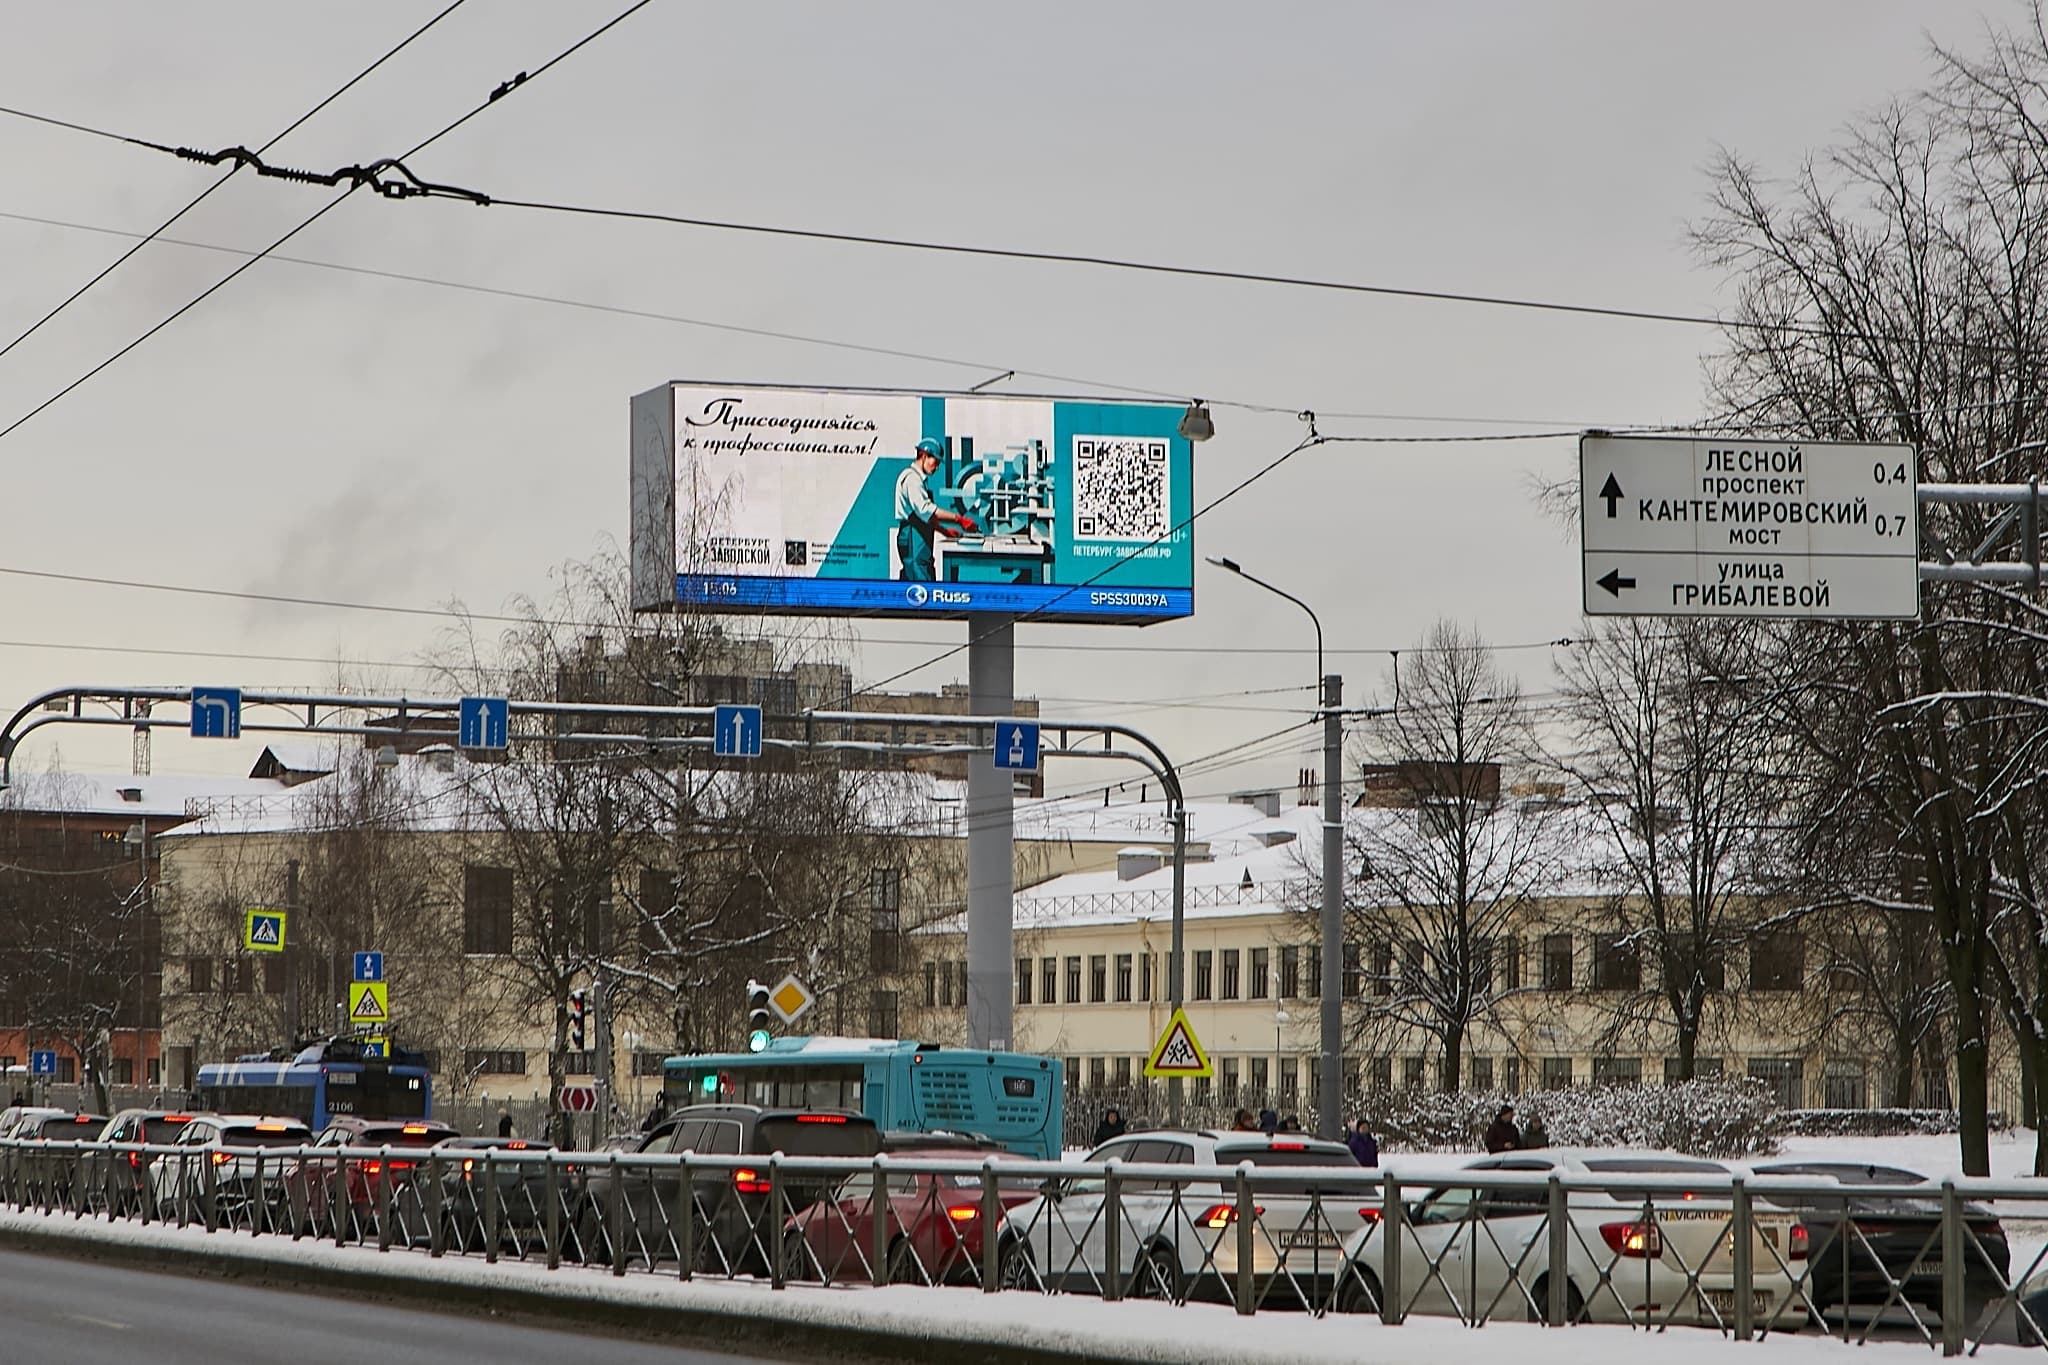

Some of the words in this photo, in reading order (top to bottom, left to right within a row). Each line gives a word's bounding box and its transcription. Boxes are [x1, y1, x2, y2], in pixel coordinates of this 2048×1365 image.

[685, 398, 878, 434] Присоединяйся
[684, 437, 697, 449] к
[703, 433, 878, 456] профессионалам!
[1705, 446, 1802, 473] ЛЕСНОЙ
[1873, 463, 1907, 485] 0,4
[1702, 477, 1805, 498] проспект
[1639, 497, 1867, 524] КАНТЕМИРОВСКИЙ
[1729, 529, 1781, 545] мост
[1875, 515, 1907, 538] 0,7
[710, 537, 770, 548] ПЕТЕРБУРГ
[710, 548, 770, 565] ЗАВОДСКОЙ
[1718, 562, 1784, 583] улица
[932, 589, 971, 603] Russ
[1090, 592, 1169, 608] SPSS30039A
[1672, 580, 1830, 608] ГРИБАЛЕВОЙ
